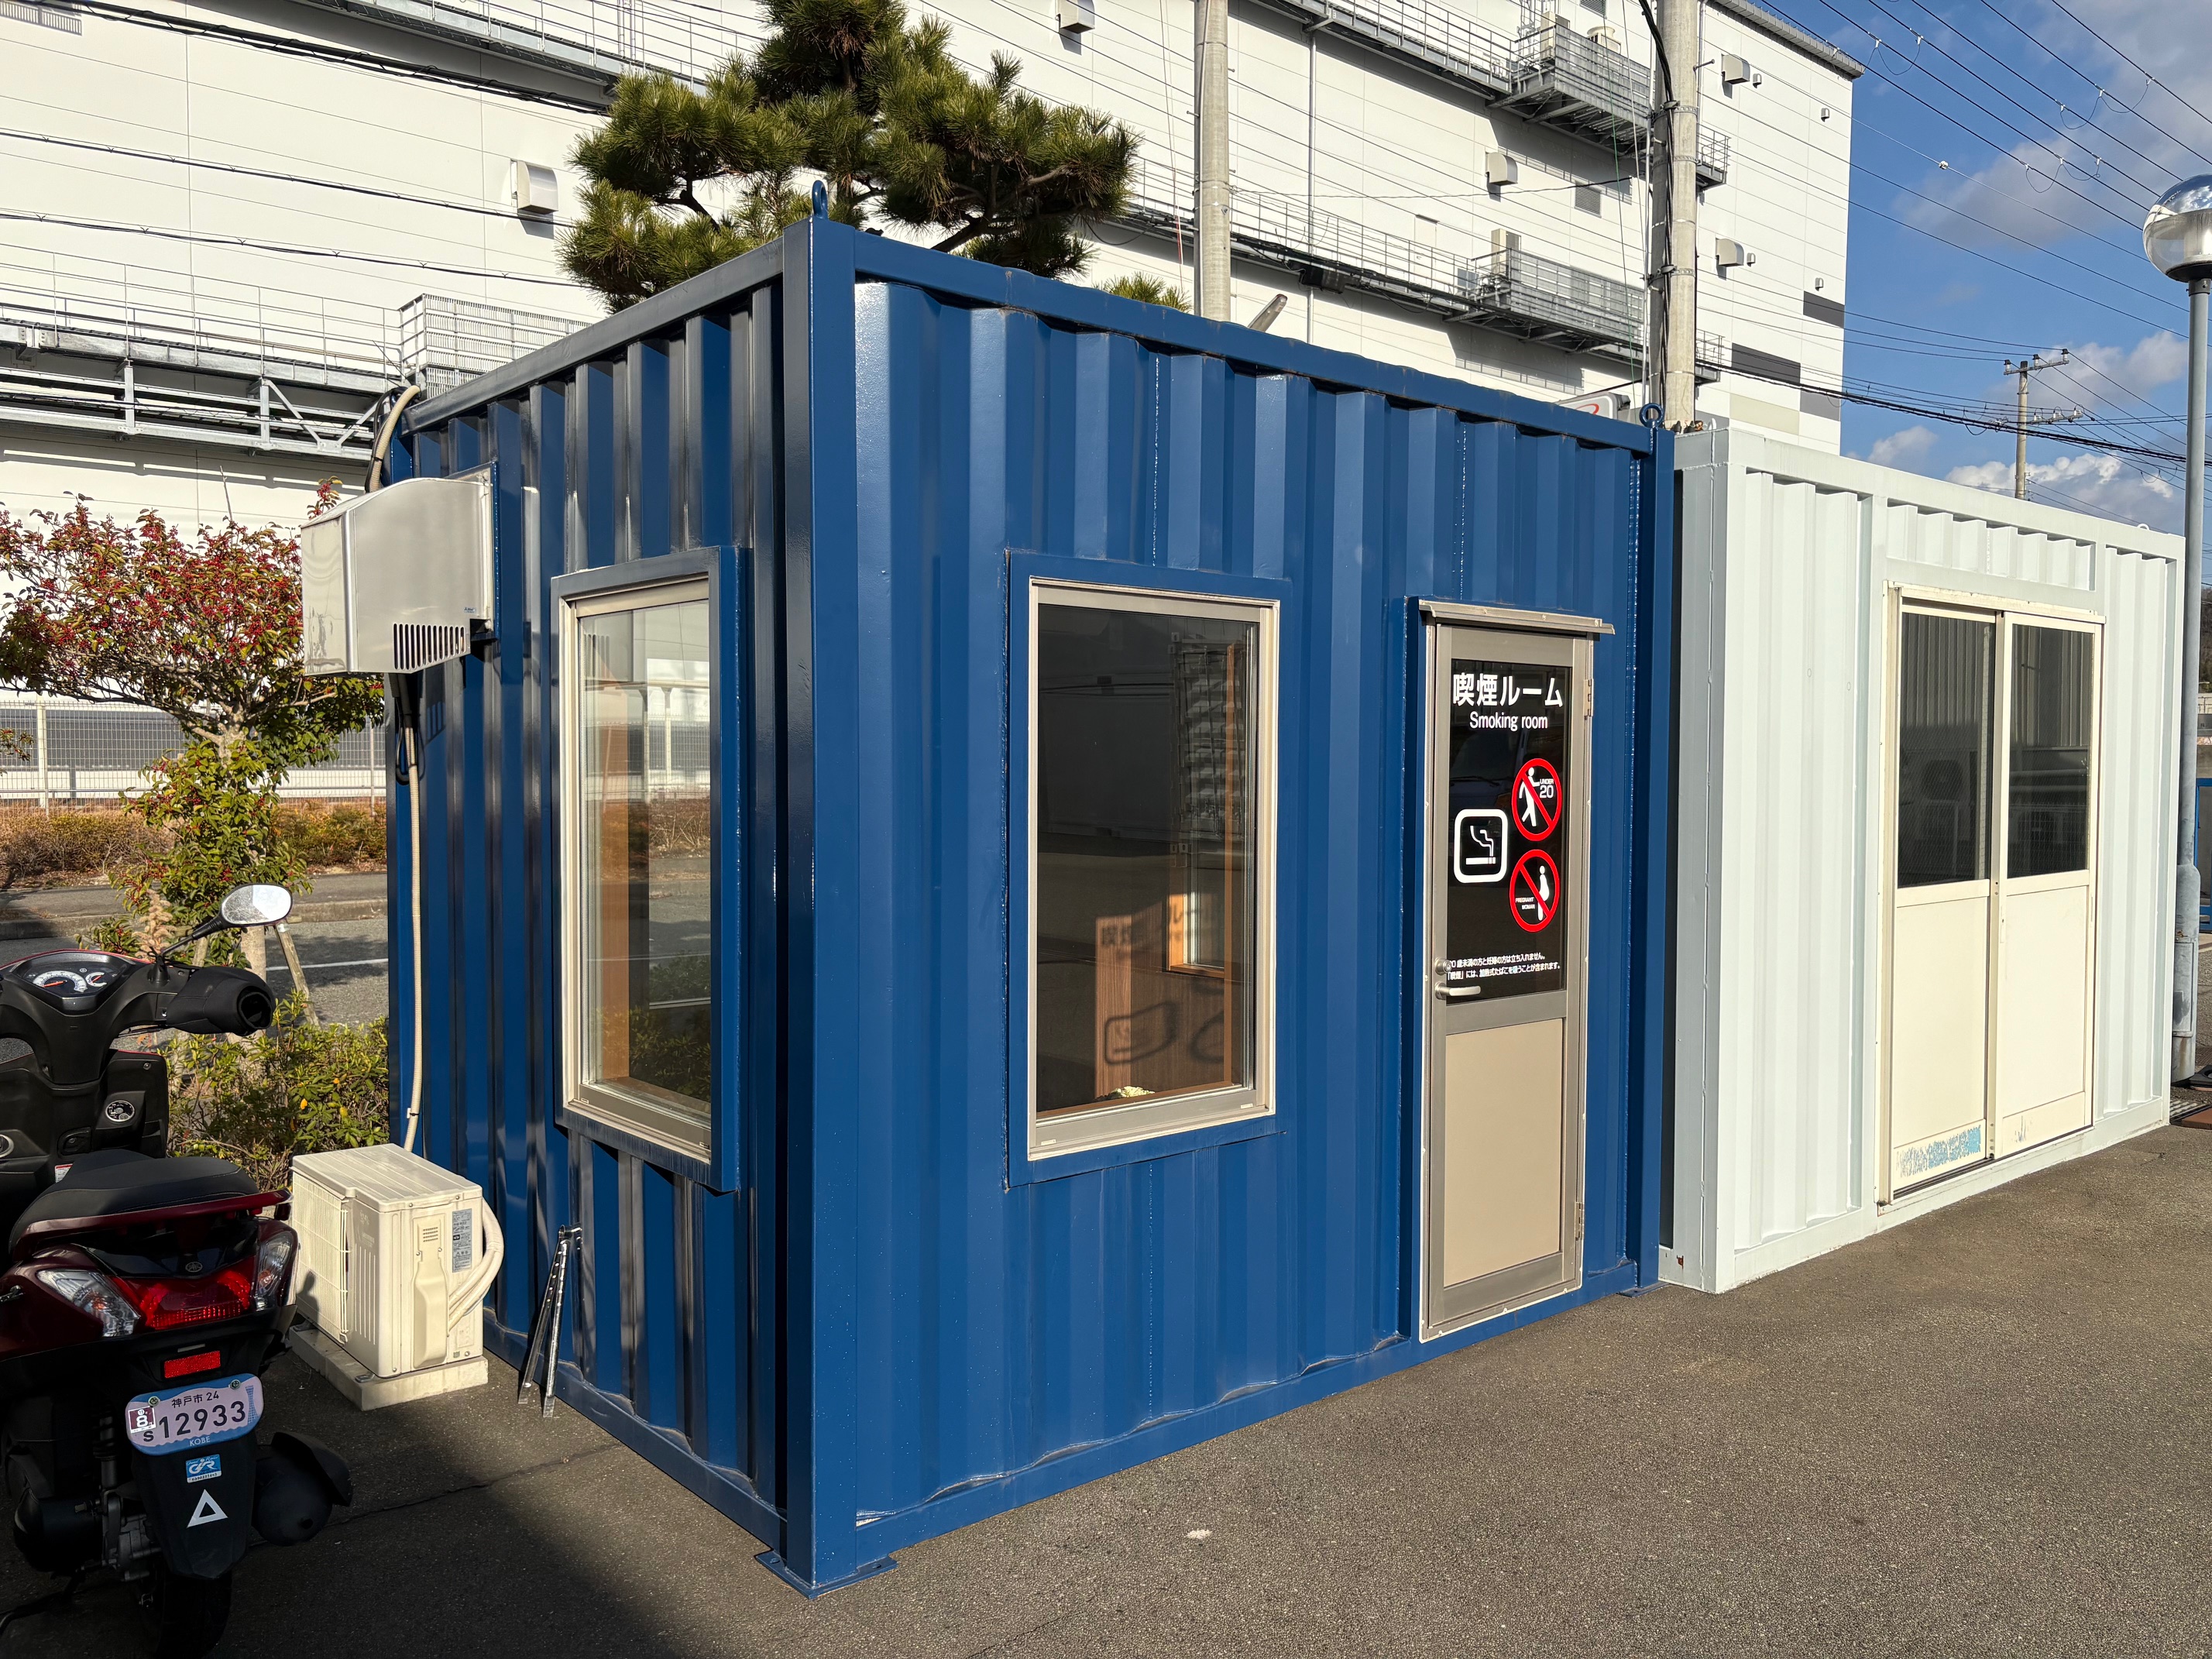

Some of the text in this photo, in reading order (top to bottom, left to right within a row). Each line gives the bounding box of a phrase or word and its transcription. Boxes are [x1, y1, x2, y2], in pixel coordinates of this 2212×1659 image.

[1452, 672, 1563, 707] 喫煙ルーム
[1469, 711, 1548, 731] Smoking room
[1539, 785, 1554, 799] 20
[171, 1391, 220, 1408] 神戸市 24
[159, 1401, 246, 1438] 12933
[189, 1435, 211, 1447] KOBE
